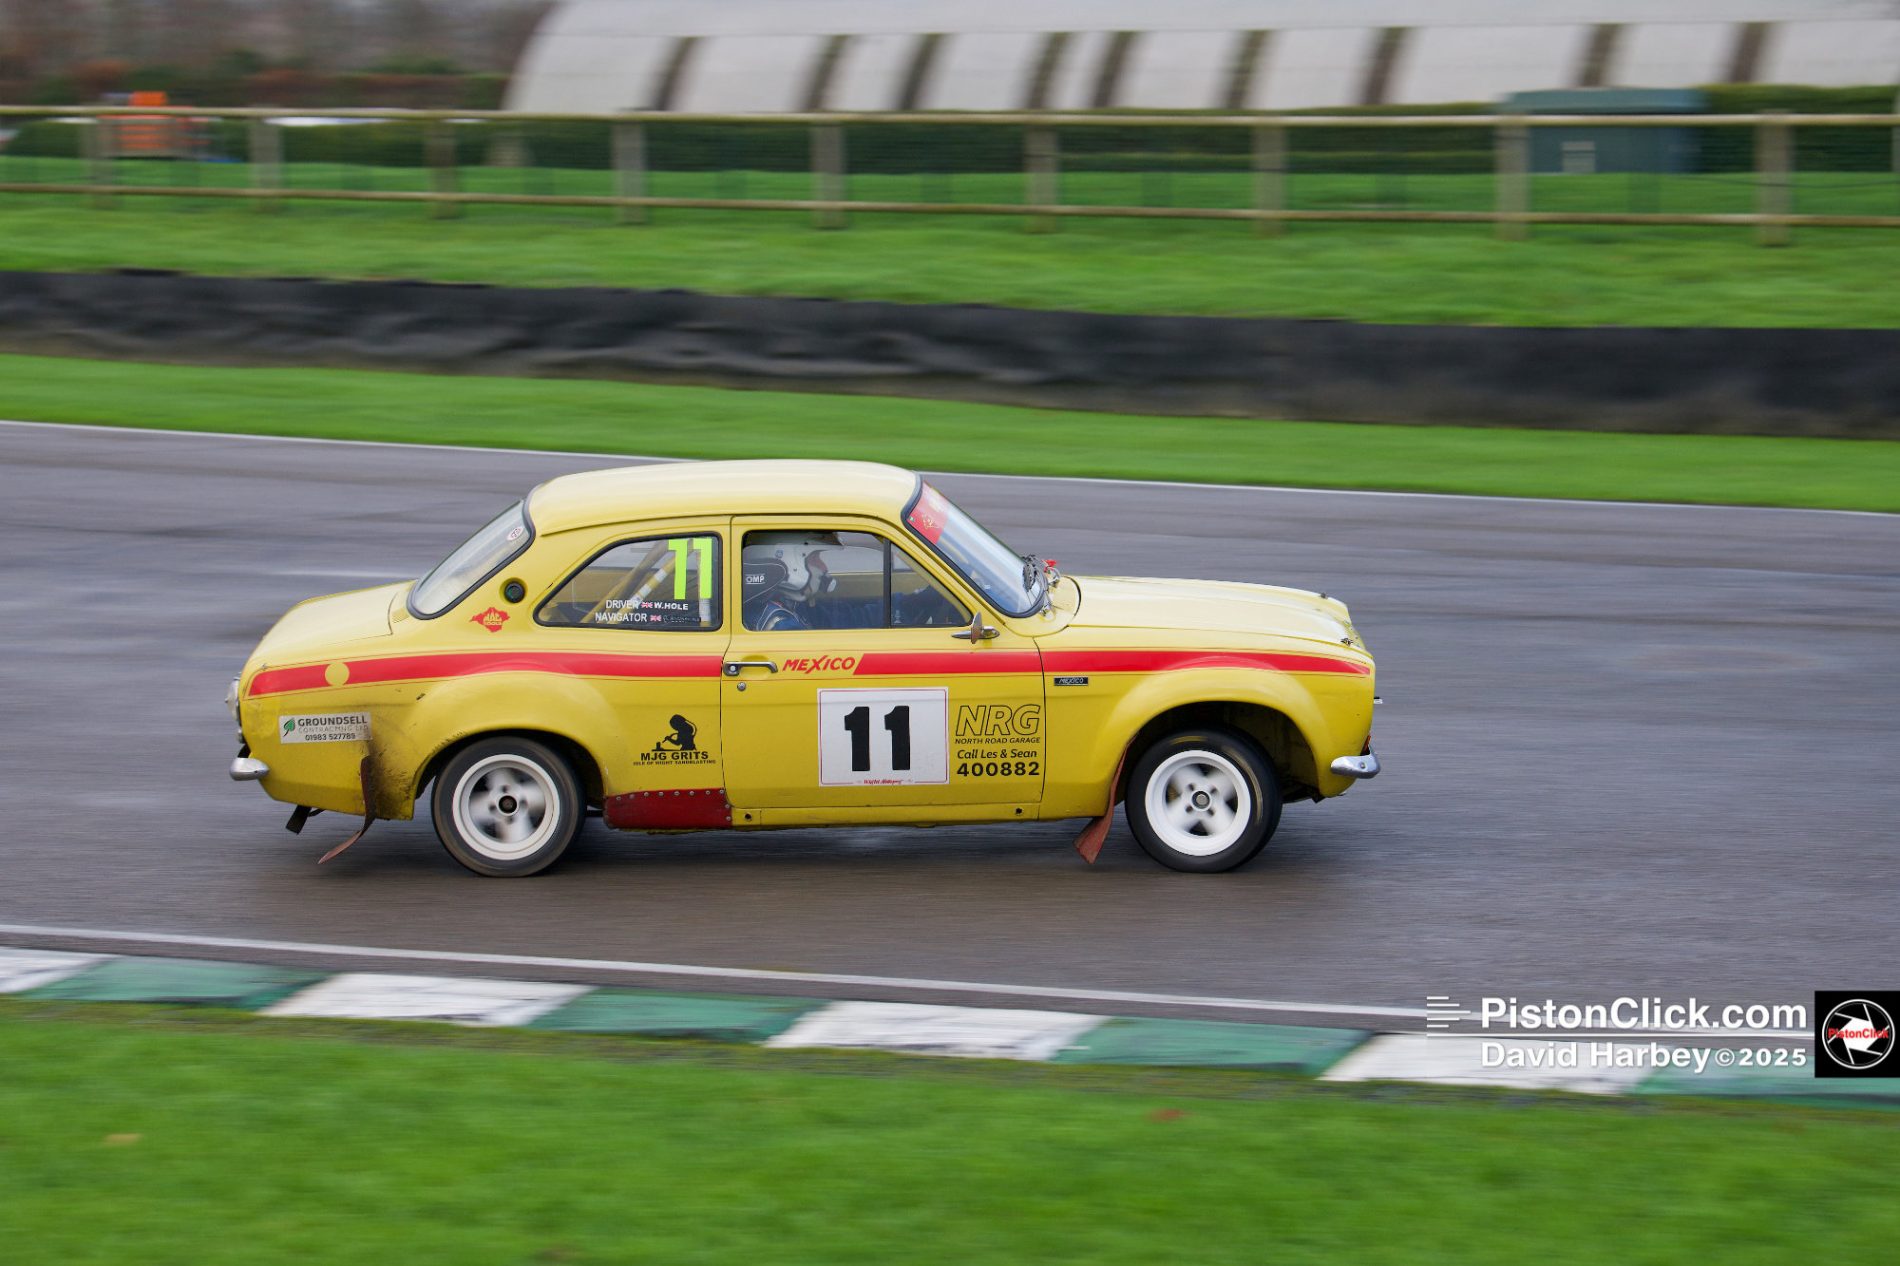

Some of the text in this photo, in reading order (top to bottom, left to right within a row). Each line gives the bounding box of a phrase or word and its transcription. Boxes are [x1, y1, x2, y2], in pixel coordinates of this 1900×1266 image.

[668, 537, 712, 600] 11
[746, 575, 765, 583] OMP
[605, 600, 689, 610] DRIVER W.HOLE
[595, 612, 648, 622] NAVIGATOR
[782, 655, 856, 674] MEXICO
[298, 715, 368, 727] GROUNDSELL
[955, 703, 1041, 737] NRG
[305, 733, 327, 741] 01983
[844, 705, 911, 772] 11
[955, 737, 983, 745] NORTH
[1009, 736, 1041, 744] GARAGE
[640, 751, 709, 761] MJG GRITS
[957, 748, 1037, 759] Call Les & Sean
[956, 761, 1040, 777] 400882
